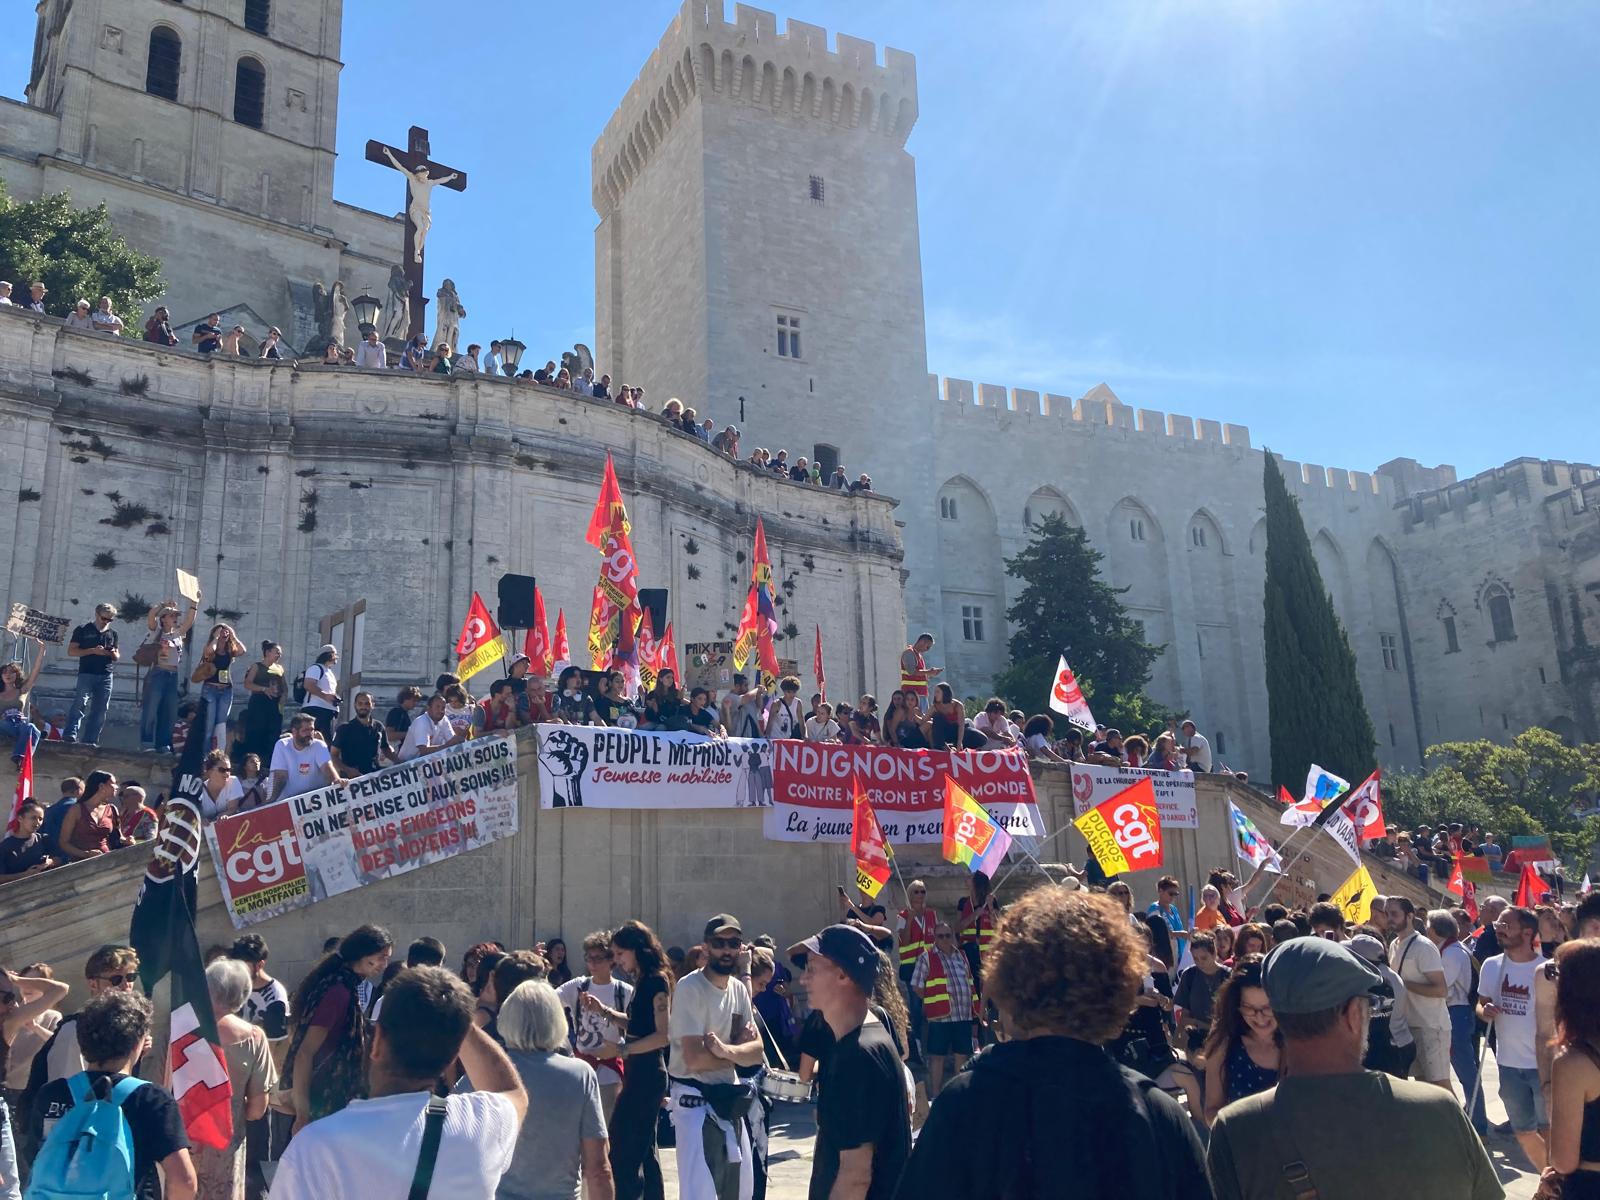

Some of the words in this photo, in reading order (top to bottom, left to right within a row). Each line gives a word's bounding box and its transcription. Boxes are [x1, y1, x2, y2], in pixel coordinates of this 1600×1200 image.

[685, 643, 711, 655] PAIX
[593, 733, 661, 764] PEUPLE
[178, 773, 203, 796] NO
[294, 794, 322, 816] ILS
[325, 786, 347, 807] NE
[350, 766, 419, 800] PENSENT
[422, 752, 472, 779] QU'AUX
[592, 766, 662, 784] Jeunesse
[667, 766, 732, 784] mobilisée
[303, 818, 326, 840] ON
[328, 811, 350, 832] NE
[352, 795, 405, 824] PENSE
[407, 780, 458, 808] QU'AUX
[460, 767, 501, 793] SOINS
[788, 783, 842, 801] CONTRE
[847, 788, 906, 804] MCRON
[911, 790, 928, 805] ET
[971, 781, 1028, 797] MONDE
[351, 822, 397, 852] NOUS
[400, 798, 476, 836] EXIGEONS
[786, 811, 808, 833] La
[812, 816, 853, 840] jeune
[882, 823, 900, 836] en
[1089, 813, 1124, 862] DUCROS
[1113, 804, 1160, 859] cgt
[226, 829, 301, 884] cgt
[361, 847, 395, 873] DES
[397, 827, 460, 862] MOYENS
[234, 892, 261, 906] CENTRE
[247, 884, 307, 912] MONTFAVET
